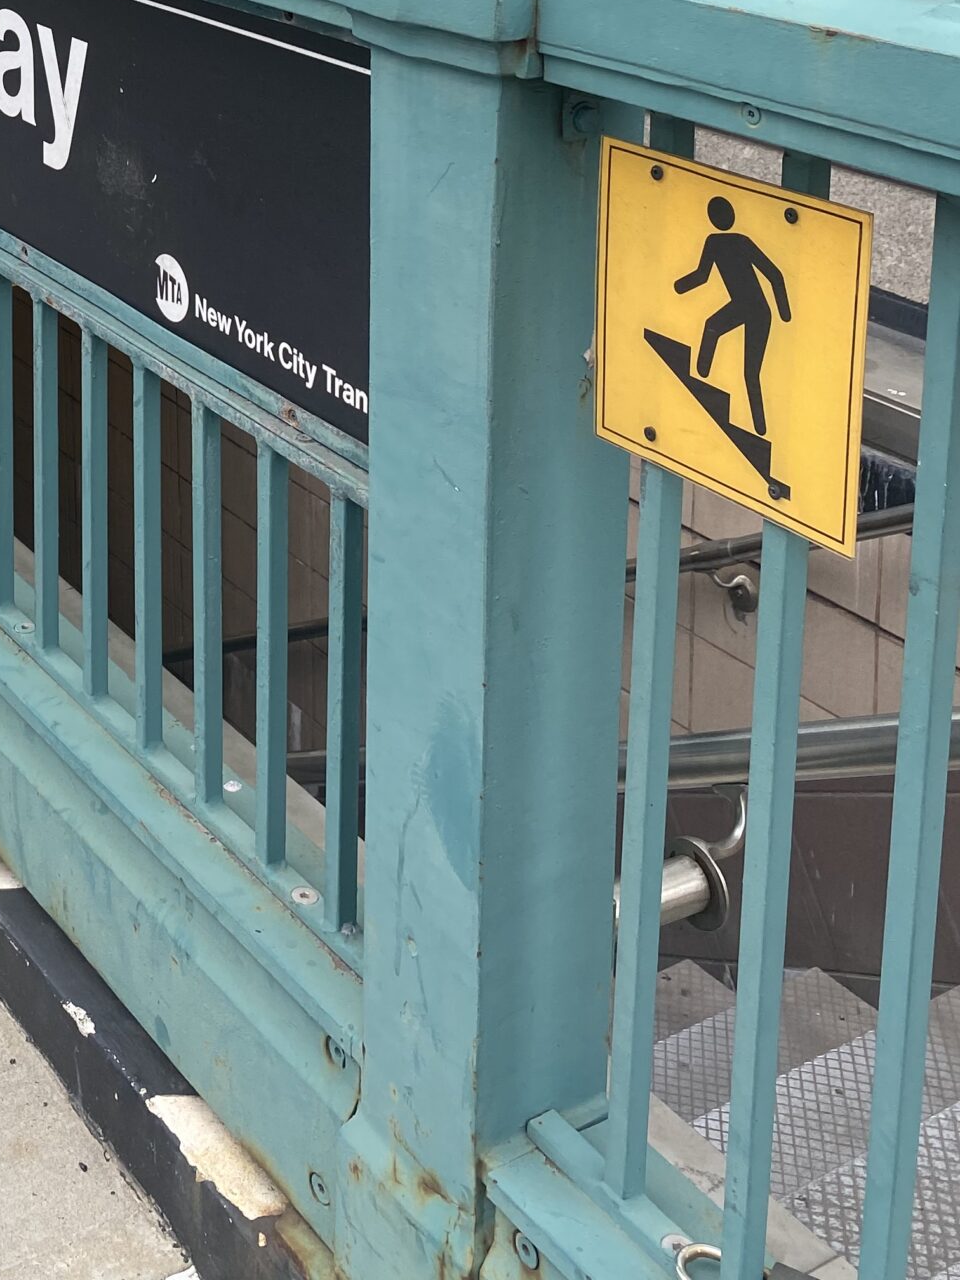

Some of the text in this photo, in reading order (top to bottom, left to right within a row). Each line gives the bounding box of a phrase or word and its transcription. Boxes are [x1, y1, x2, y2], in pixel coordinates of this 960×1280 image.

[194, 293, 233, 336] New
[233, 314, 276, 362] York
[277, 341, 318, 390] City
[321, 363, 369, 415] Tran
